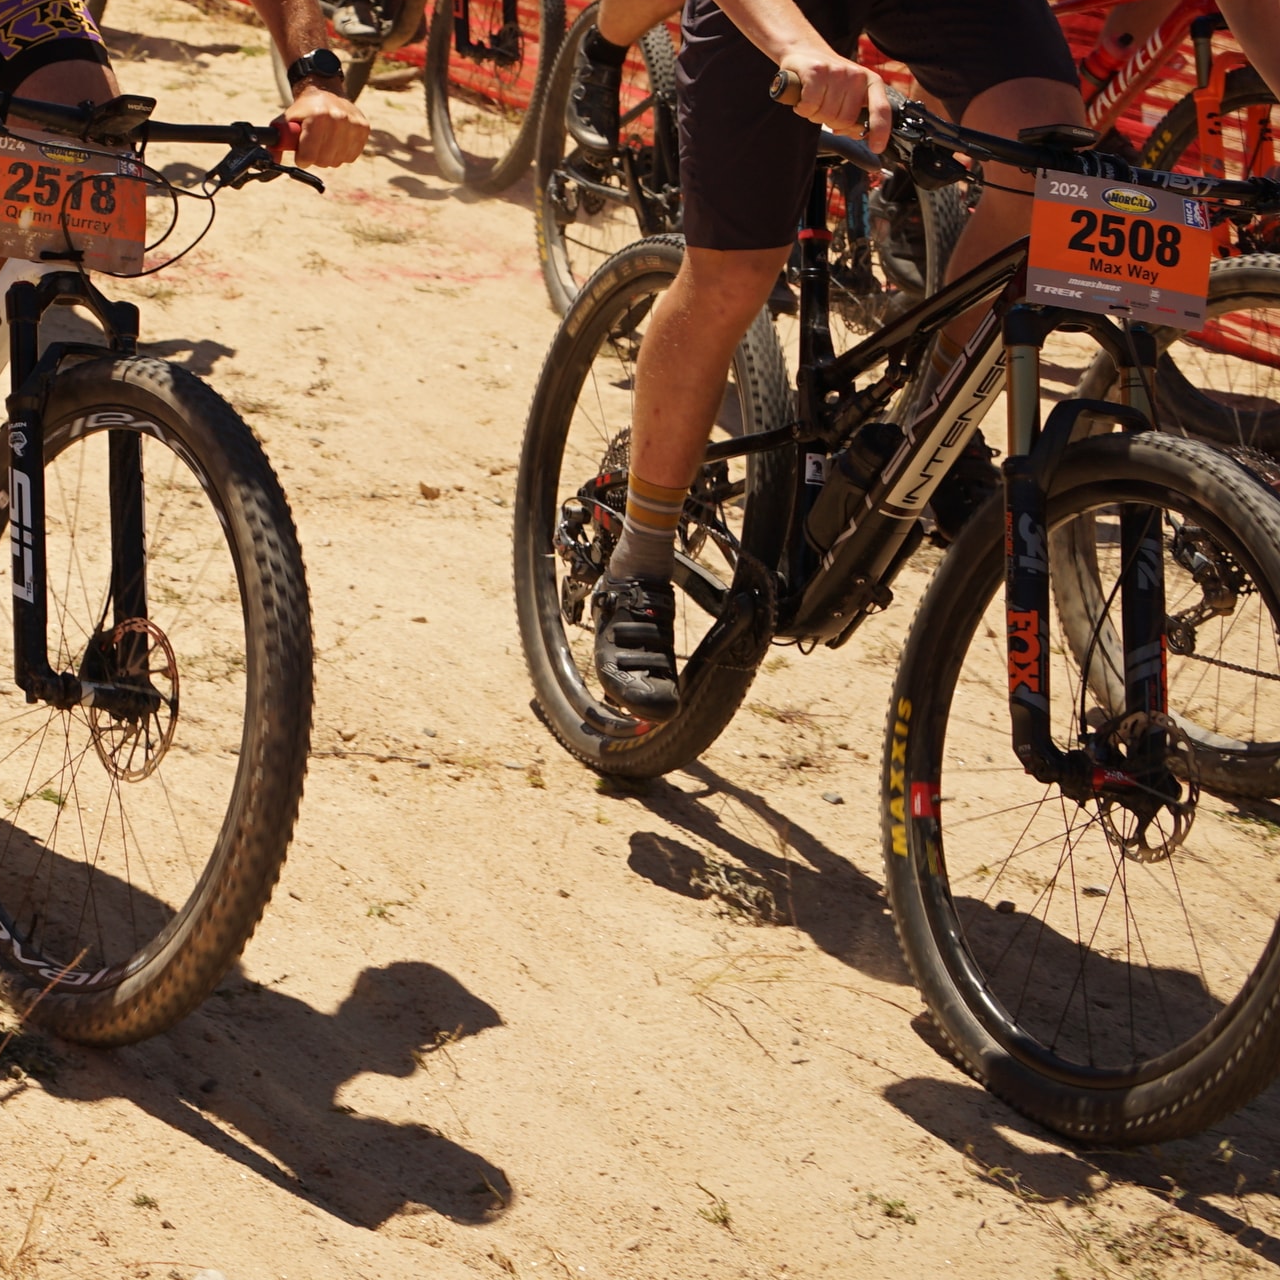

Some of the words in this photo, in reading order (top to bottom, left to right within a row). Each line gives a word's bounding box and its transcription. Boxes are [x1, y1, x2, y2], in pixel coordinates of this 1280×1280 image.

[127, 103, 152, 112] wahoo
[3, 161, 117, 215] 2518
[1049, 181, 1089, 200] 2024
[1067, 209, 1182, 268] 2508
[1033, 283, 1085, 299] TREK
[1089, 257, 1122, 276] Max
[1127, 263, 1159, 285] Way
[1008, 609, 1041, 694] FOX
[889, 695, 913, 859] MAXXIS
